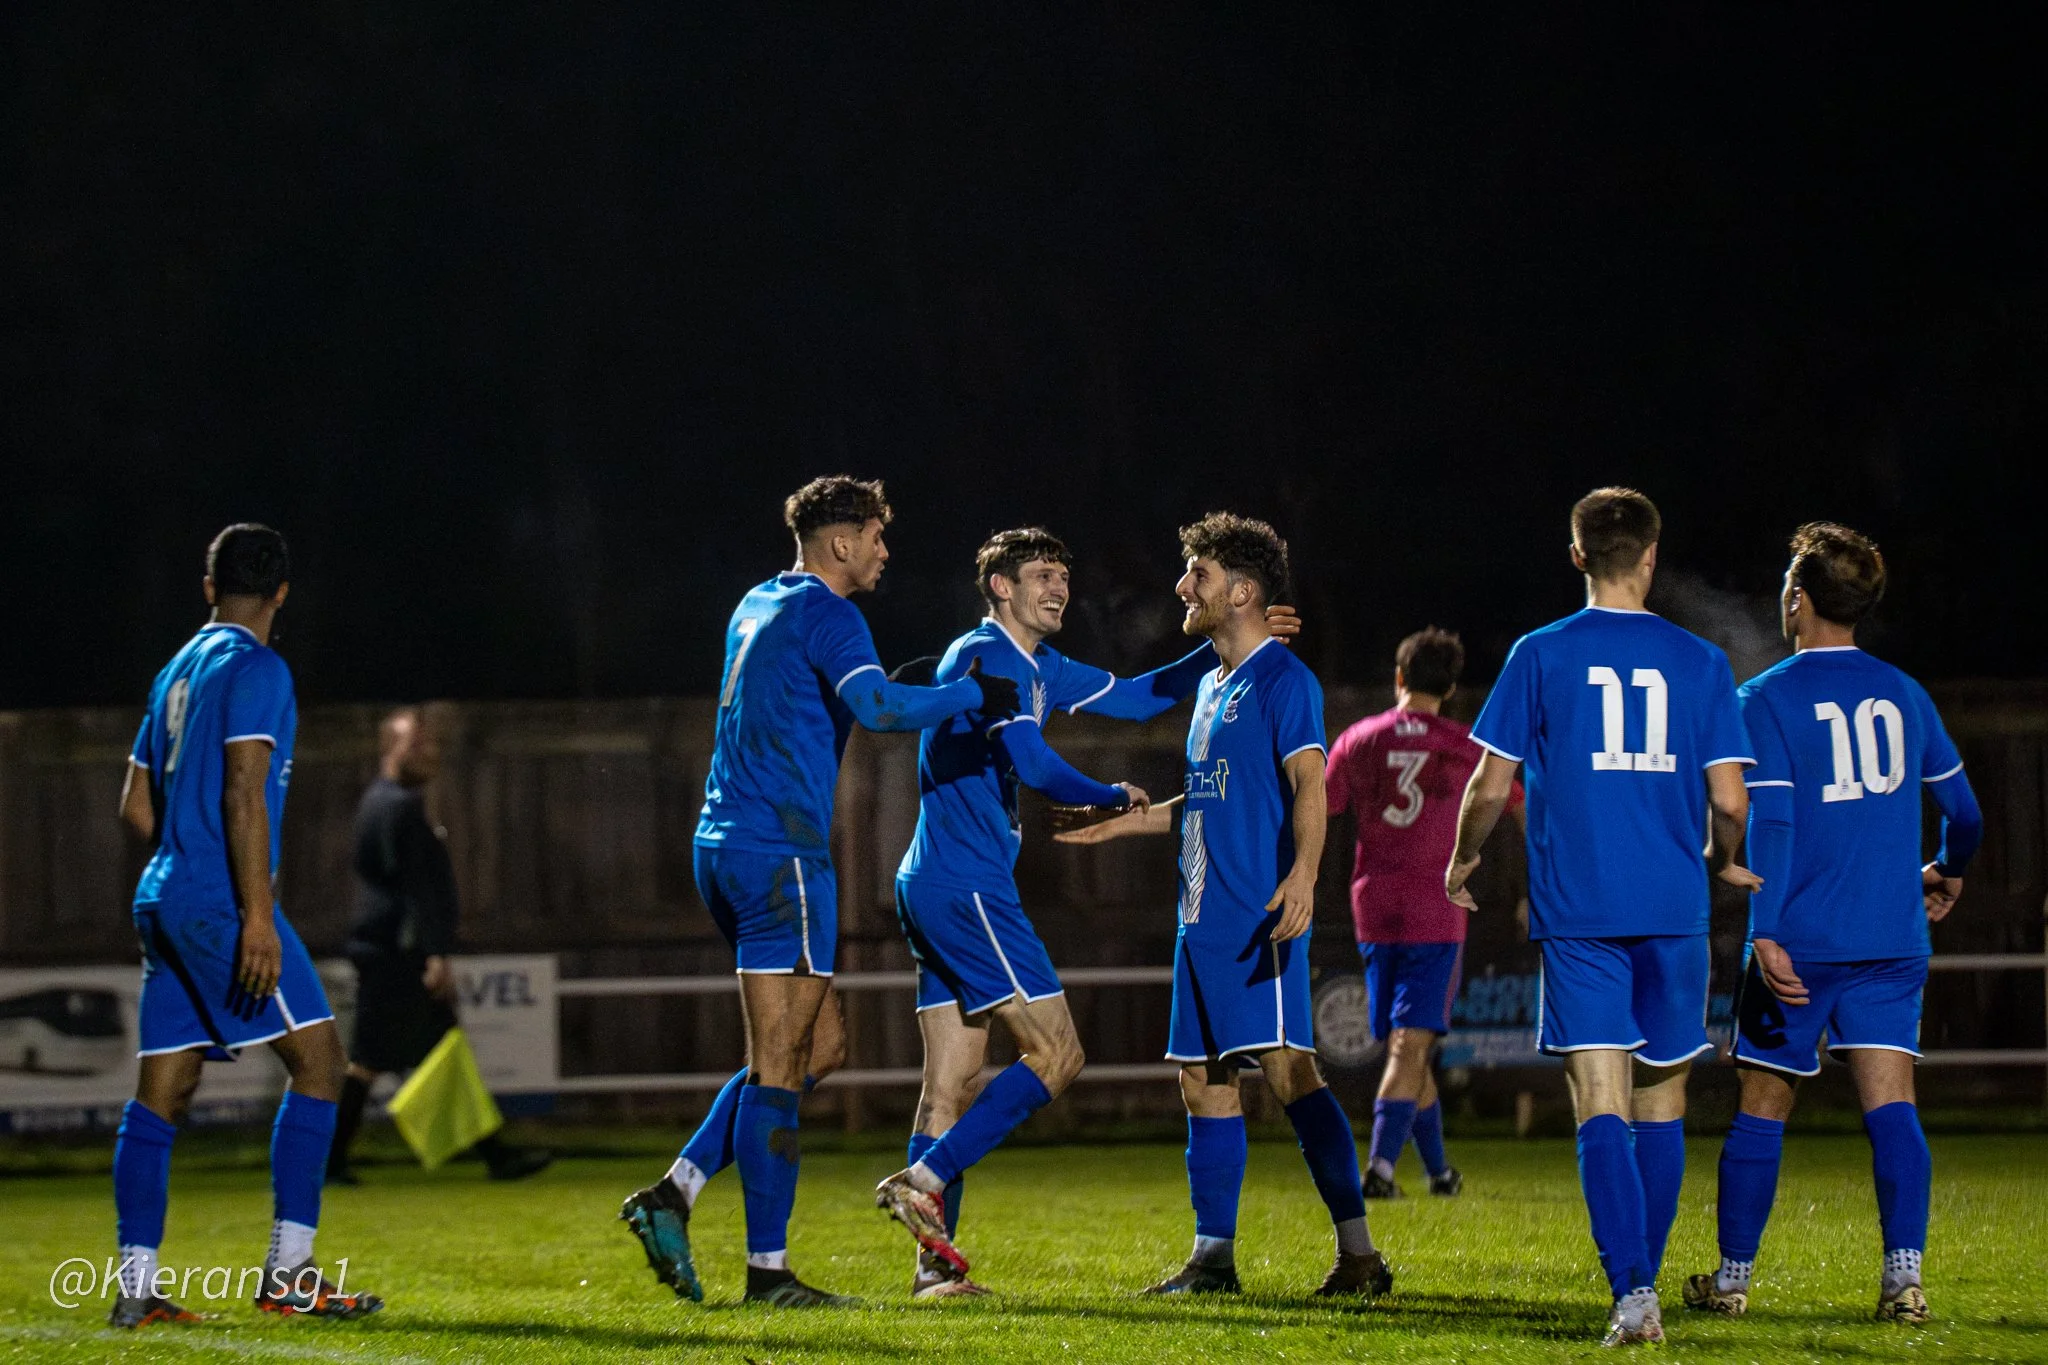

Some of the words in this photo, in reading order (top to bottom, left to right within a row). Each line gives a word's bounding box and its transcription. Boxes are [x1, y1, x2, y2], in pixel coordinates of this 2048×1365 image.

[164, 677, 190, 774] 9
[1587, 665, 1677, 773] 11
[1813, 696, 1905, 803] 10
[1382, 750, 1431, 828] 3
